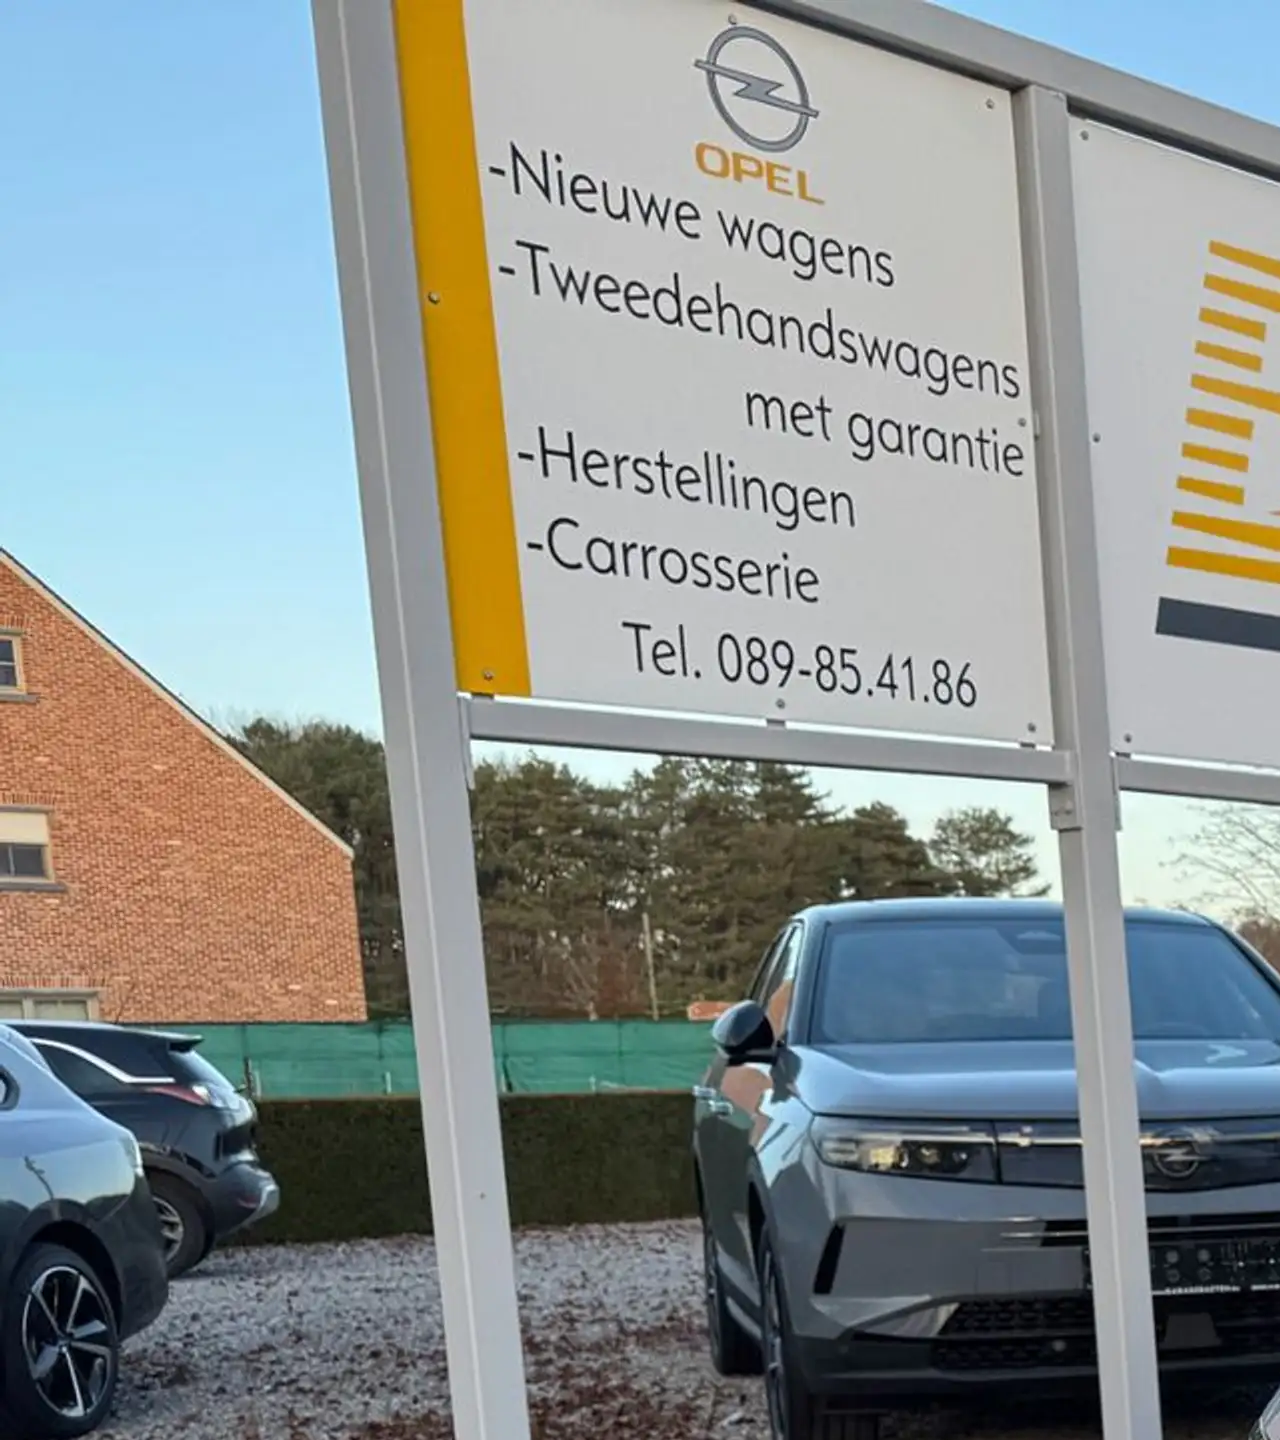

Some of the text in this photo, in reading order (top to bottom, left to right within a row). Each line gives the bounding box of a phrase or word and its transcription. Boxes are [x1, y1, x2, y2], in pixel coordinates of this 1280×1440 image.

[489, 141, 894, 287] -Nieuwe wagens
[694, 142, 825, 205] OPEL
[498, 239, 1020, 399] -Tweedehandswagens
[517, 426, 855, 531] -Herstellingen
[746, 392, 1024, 477] met garantie
[526, 517, 819, 605] -Carrosserie
[621, 621, 977, 708] Tel. 089-85.41.86
